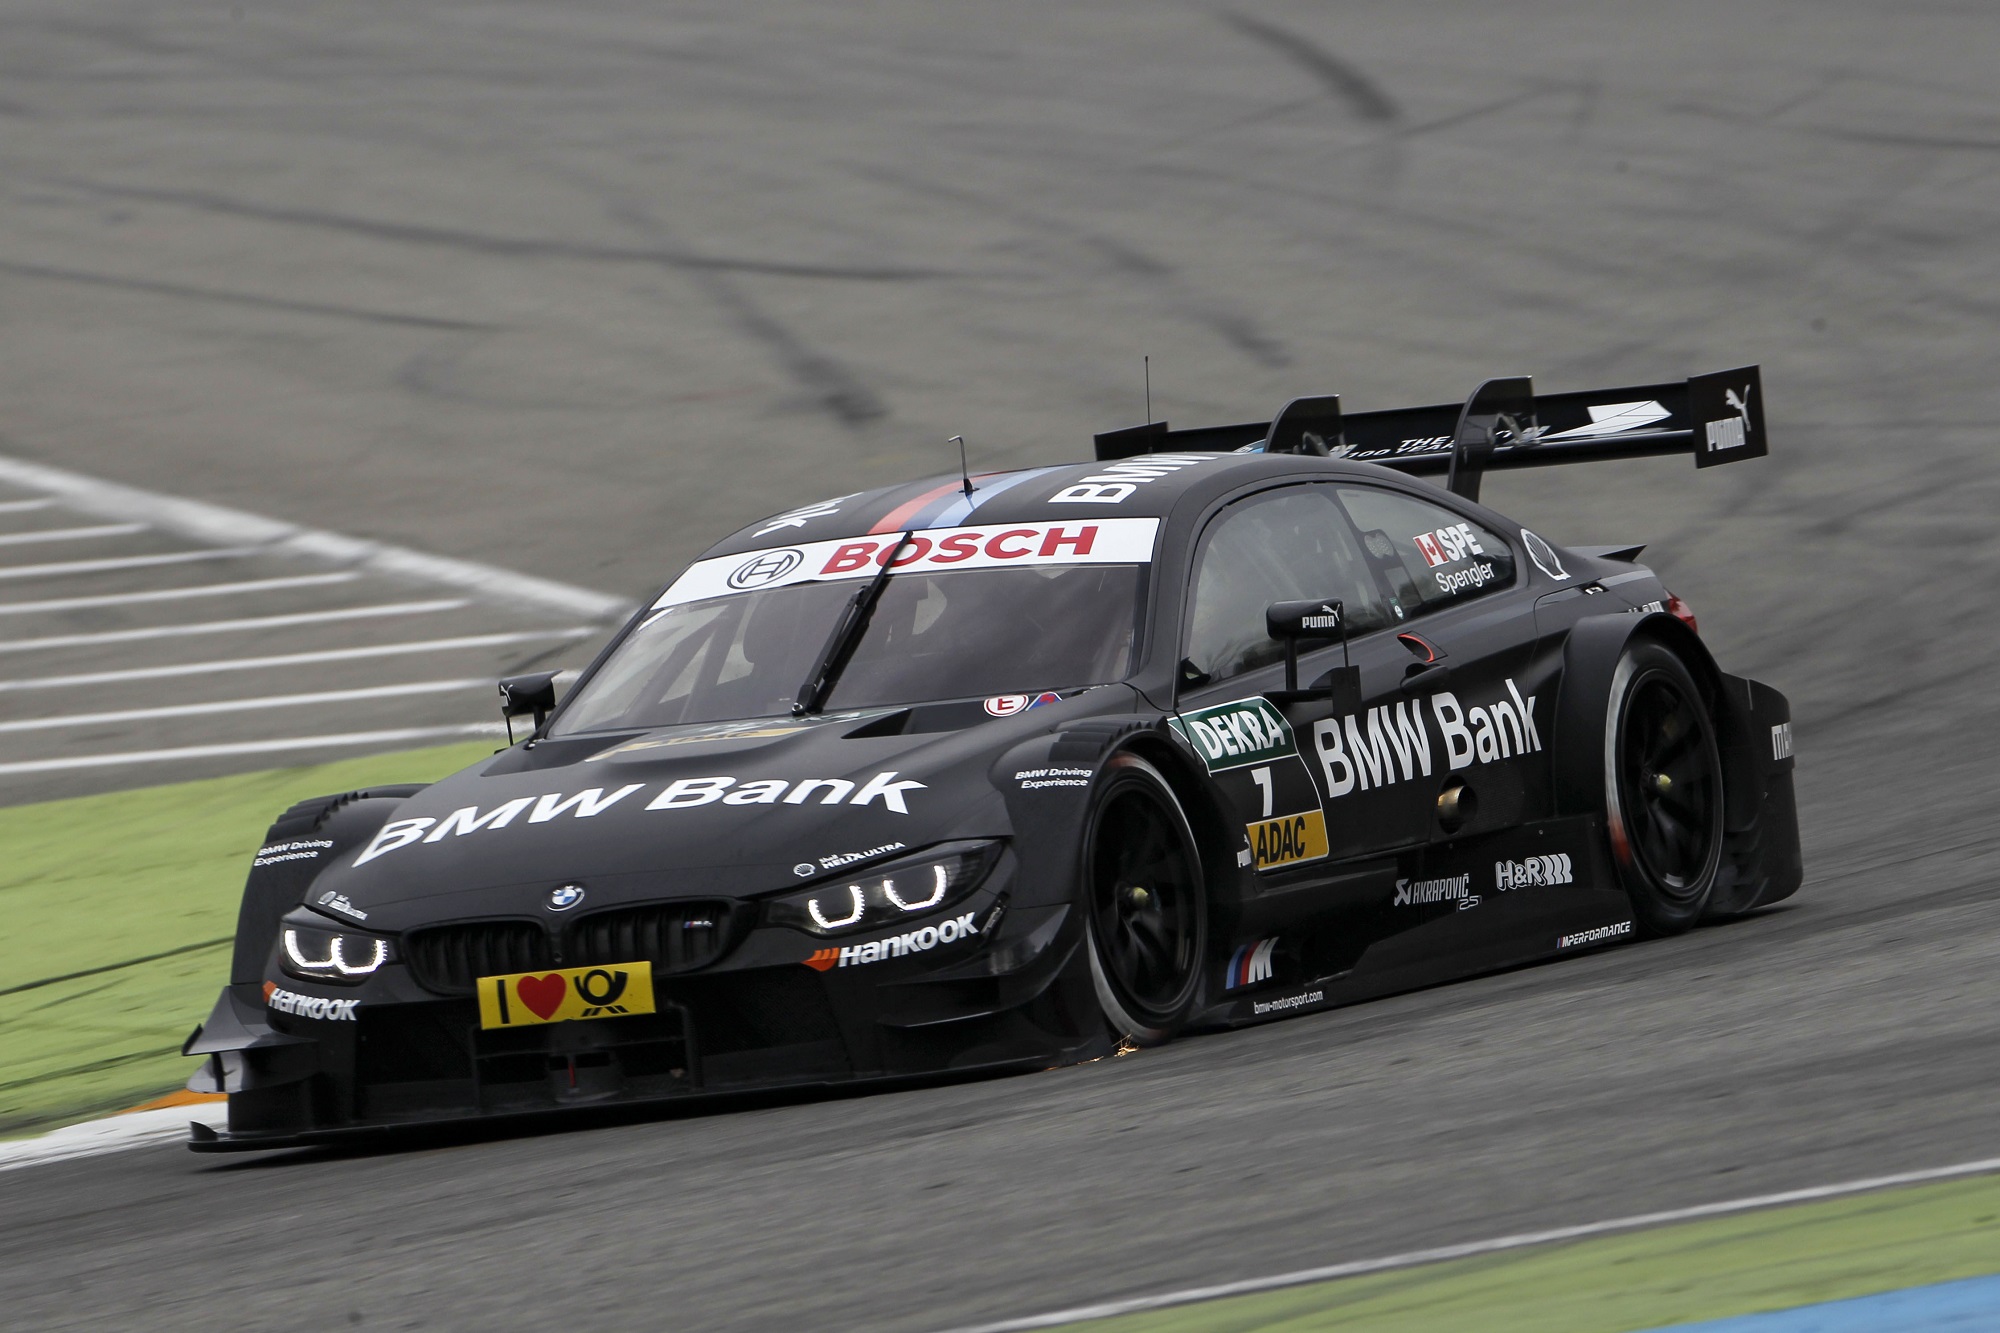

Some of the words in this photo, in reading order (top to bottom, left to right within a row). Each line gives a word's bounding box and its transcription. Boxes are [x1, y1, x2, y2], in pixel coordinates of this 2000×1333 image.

[1401, 435, 1451, 449] THE
[820, 525, 1099, 575] BOSCH
[1436, 523, 1484, 562] SPE
[1435, 561, 1495, 595] Spengler
[1302, 615, 1336, 629] PUMA
[1189, 706, 1286, 760] DEKRA
[1314, 699, 1431, 798] BMW
[1432, 678, 1542, 770] Bank
[1015, 769, 1048, 780] BMW
[1048, 767, 1093, 778] Driving
[1021, 778, 1088, 789] Experience
[1251, 766, 1273, 817] 7
[351, 783, 647, 869] BMW
[645, 771, 928, 815] Bank
[253, 850, 319, 867] Experience
[257, 843, 290, 856] BMW
[290, 839, 334, 850] Driving
[821, 853, 866, 869] HELIX
[863, 842, 906, 857] ULTRA
[1256, 816, 1306, 867] ADAC
[1495, 857, 1547, 891] H&R
[497, 979, 511, 1024] I
[1253, 990, 1324, 1015] bmw-motorsport.com
